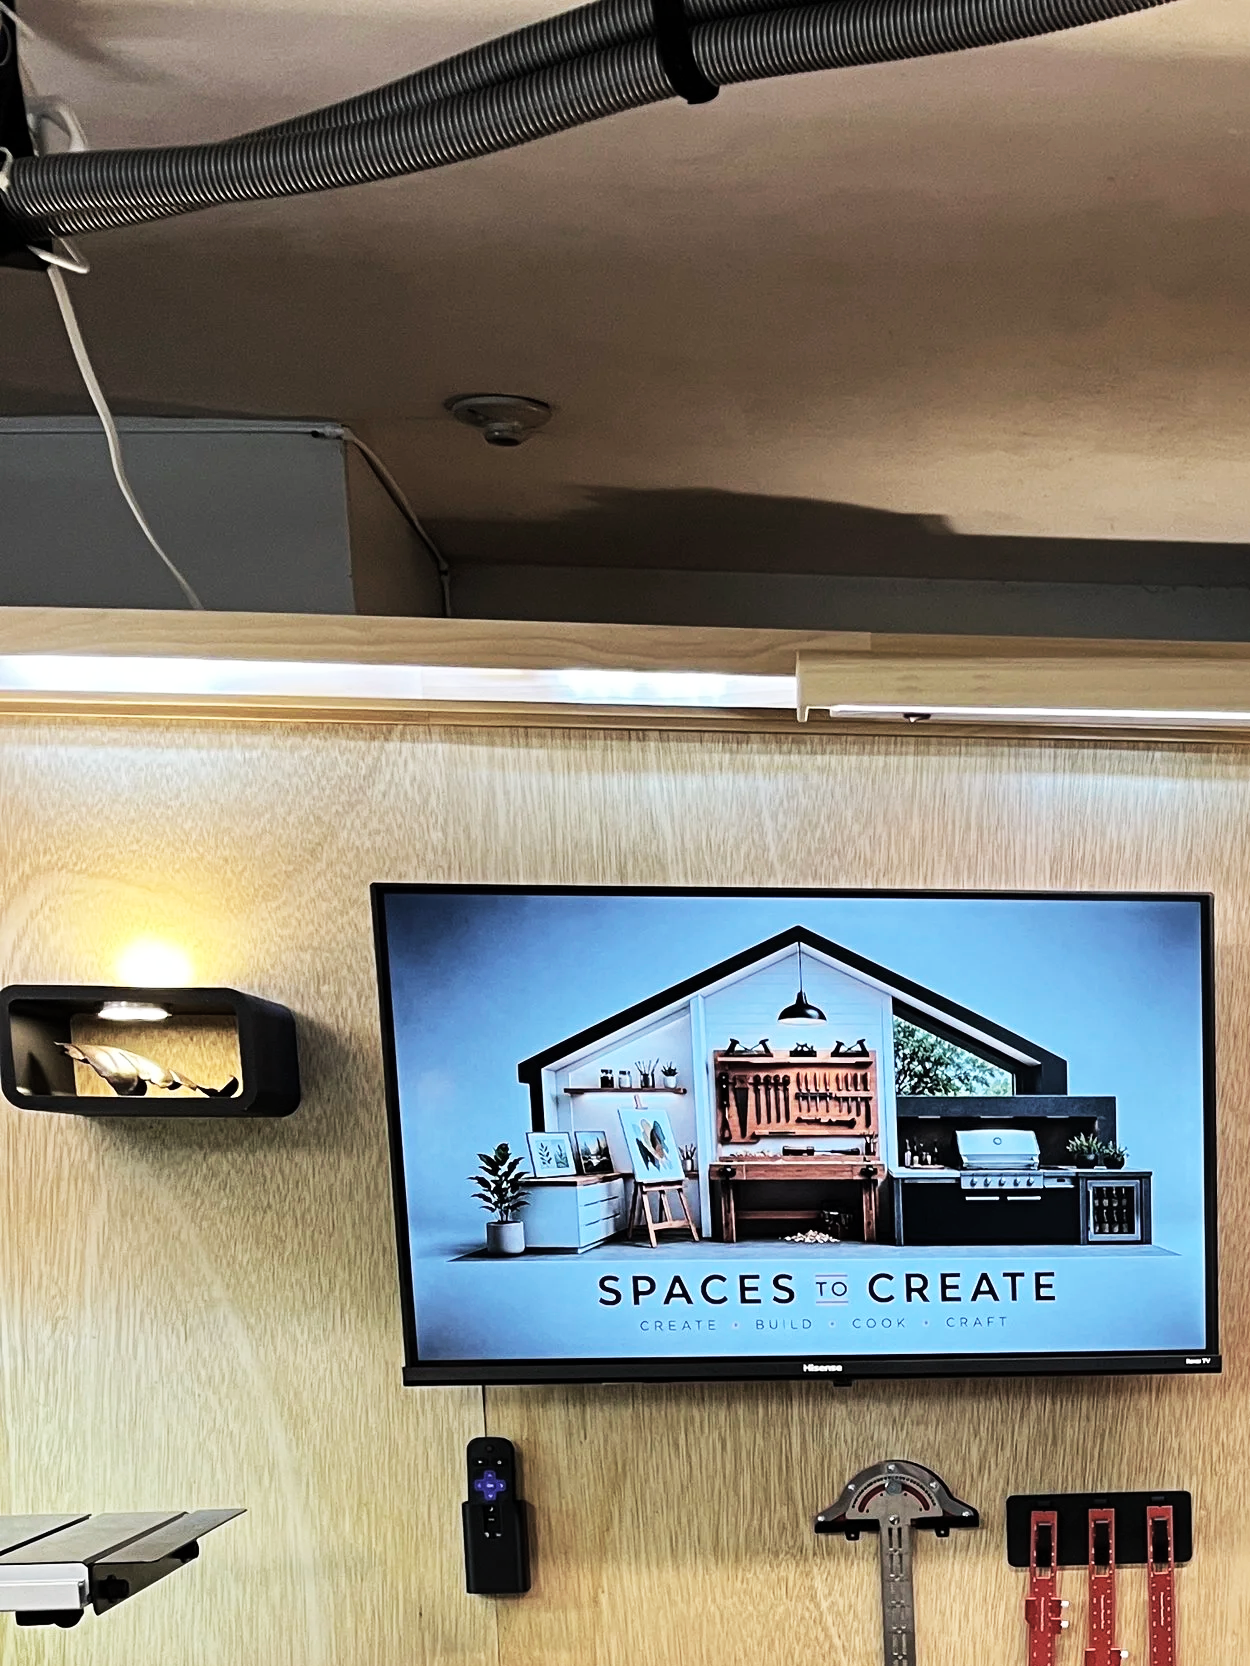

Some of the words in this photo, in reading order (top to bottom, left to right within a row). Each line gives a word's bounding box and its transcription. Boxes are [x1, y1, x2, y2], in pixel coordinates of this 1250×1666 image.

[599, 1273, 795, 1306] SPACES
[816, 1281, 848, 1297] TO
[868, 1271, 1056, 1303] CREATE
[640, 1319, 716, 1332] CREATE
[756, 1318, 812, 1330] BUILD
[852, 1317, 905, 1329] COOK
[946, 1316, 1007, 1328] CRAFT
[803, 1363, 843, 1373] Hisense
